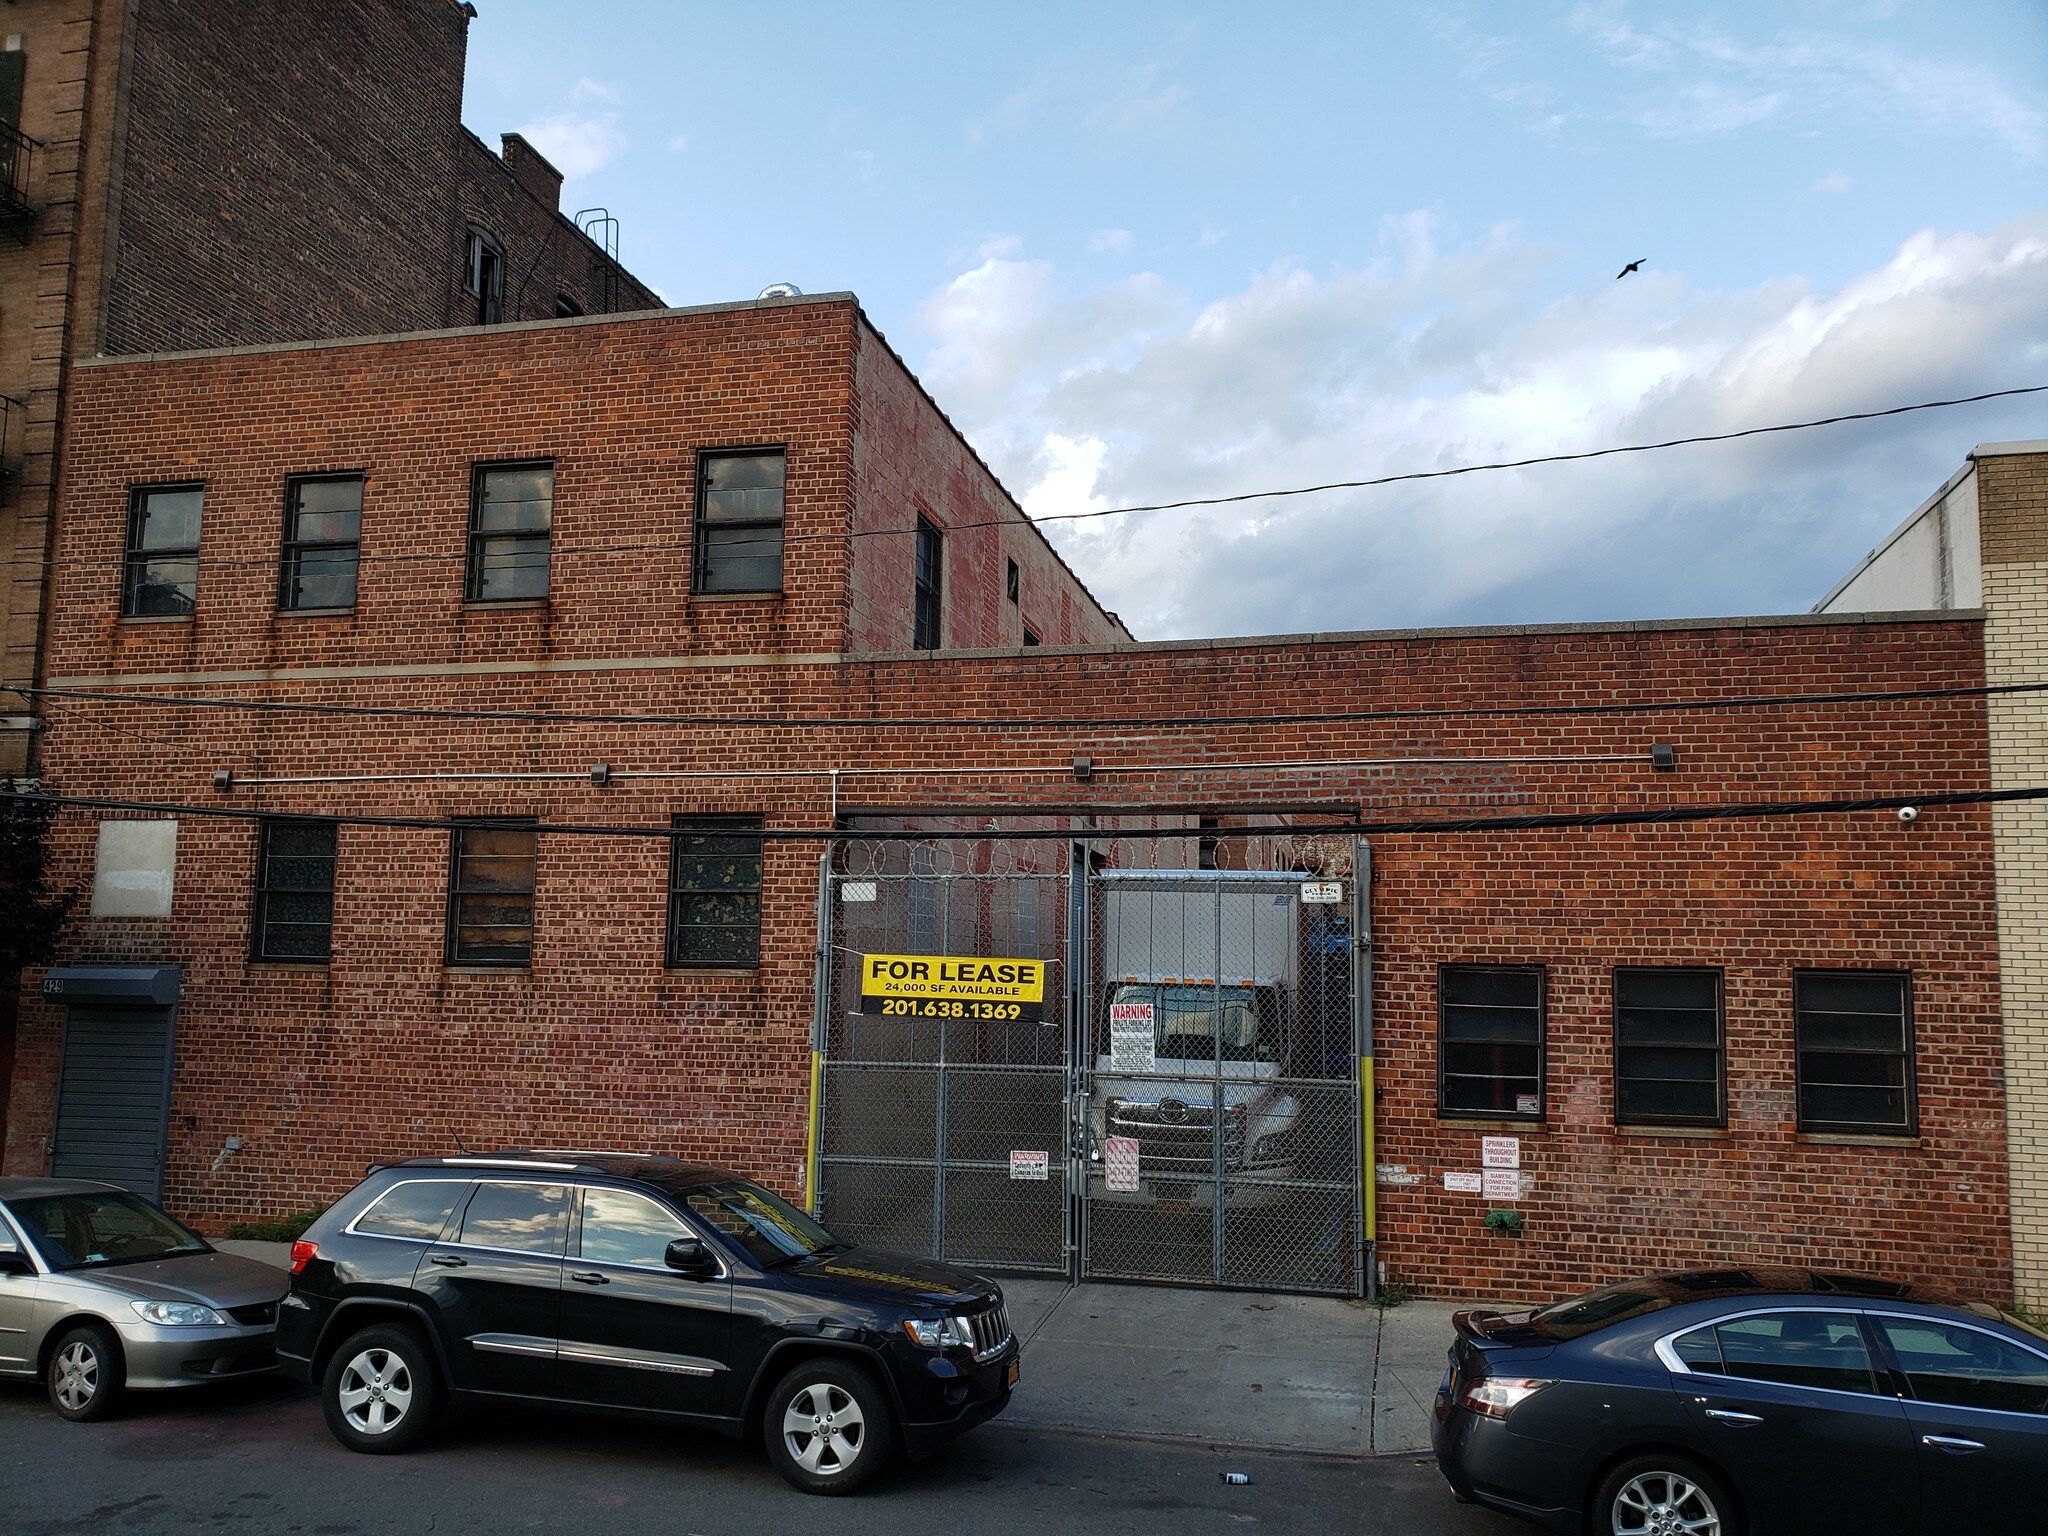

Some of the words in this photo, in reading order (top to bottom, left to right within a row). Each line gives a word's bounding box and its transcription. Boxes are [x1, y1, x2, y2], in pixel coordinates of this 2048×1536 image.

[872, 961, 929, 981] FOR
[940, 963, 1036, 984] LEASE
[44, 980, 63, 992] 429
[885, 982, 926, 993] 24,000
[930, 984, 945, 993] SF
[949, 984, 1020, 996] AVAILABLE
[882, 999, 1021, 1020] 201.638.1369
[1112, 1004, 1152, 1019] WARNING
[1485, 1140, 1516, 1148] SPRINKLERS
[1485, 1148, 1517, 1156] THROUGHOUT
[1489, 1156, 1512, 1164] BUILDING
